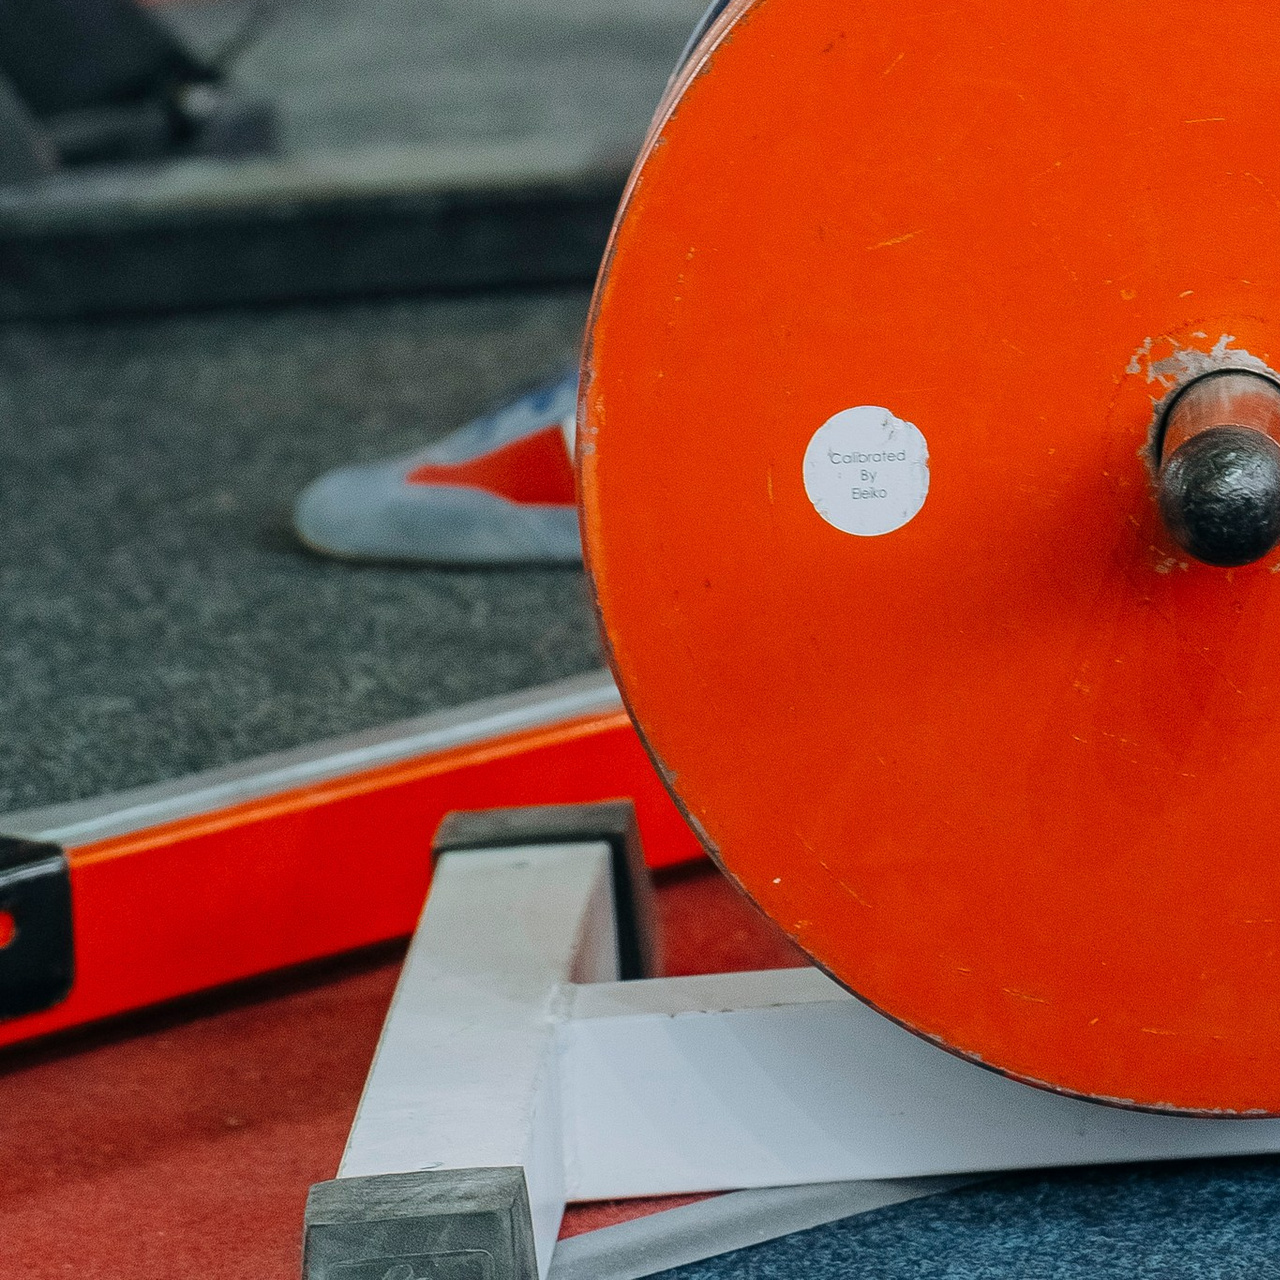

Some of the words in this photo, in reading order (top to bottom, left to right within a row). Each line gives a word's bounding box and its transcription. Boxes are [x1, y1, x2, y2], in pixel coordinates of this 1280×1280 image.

[830, 450, 906, 464] Calibrated
[860, 469, 877, 482] By
[851, 487, 887, 500] Eleiko
